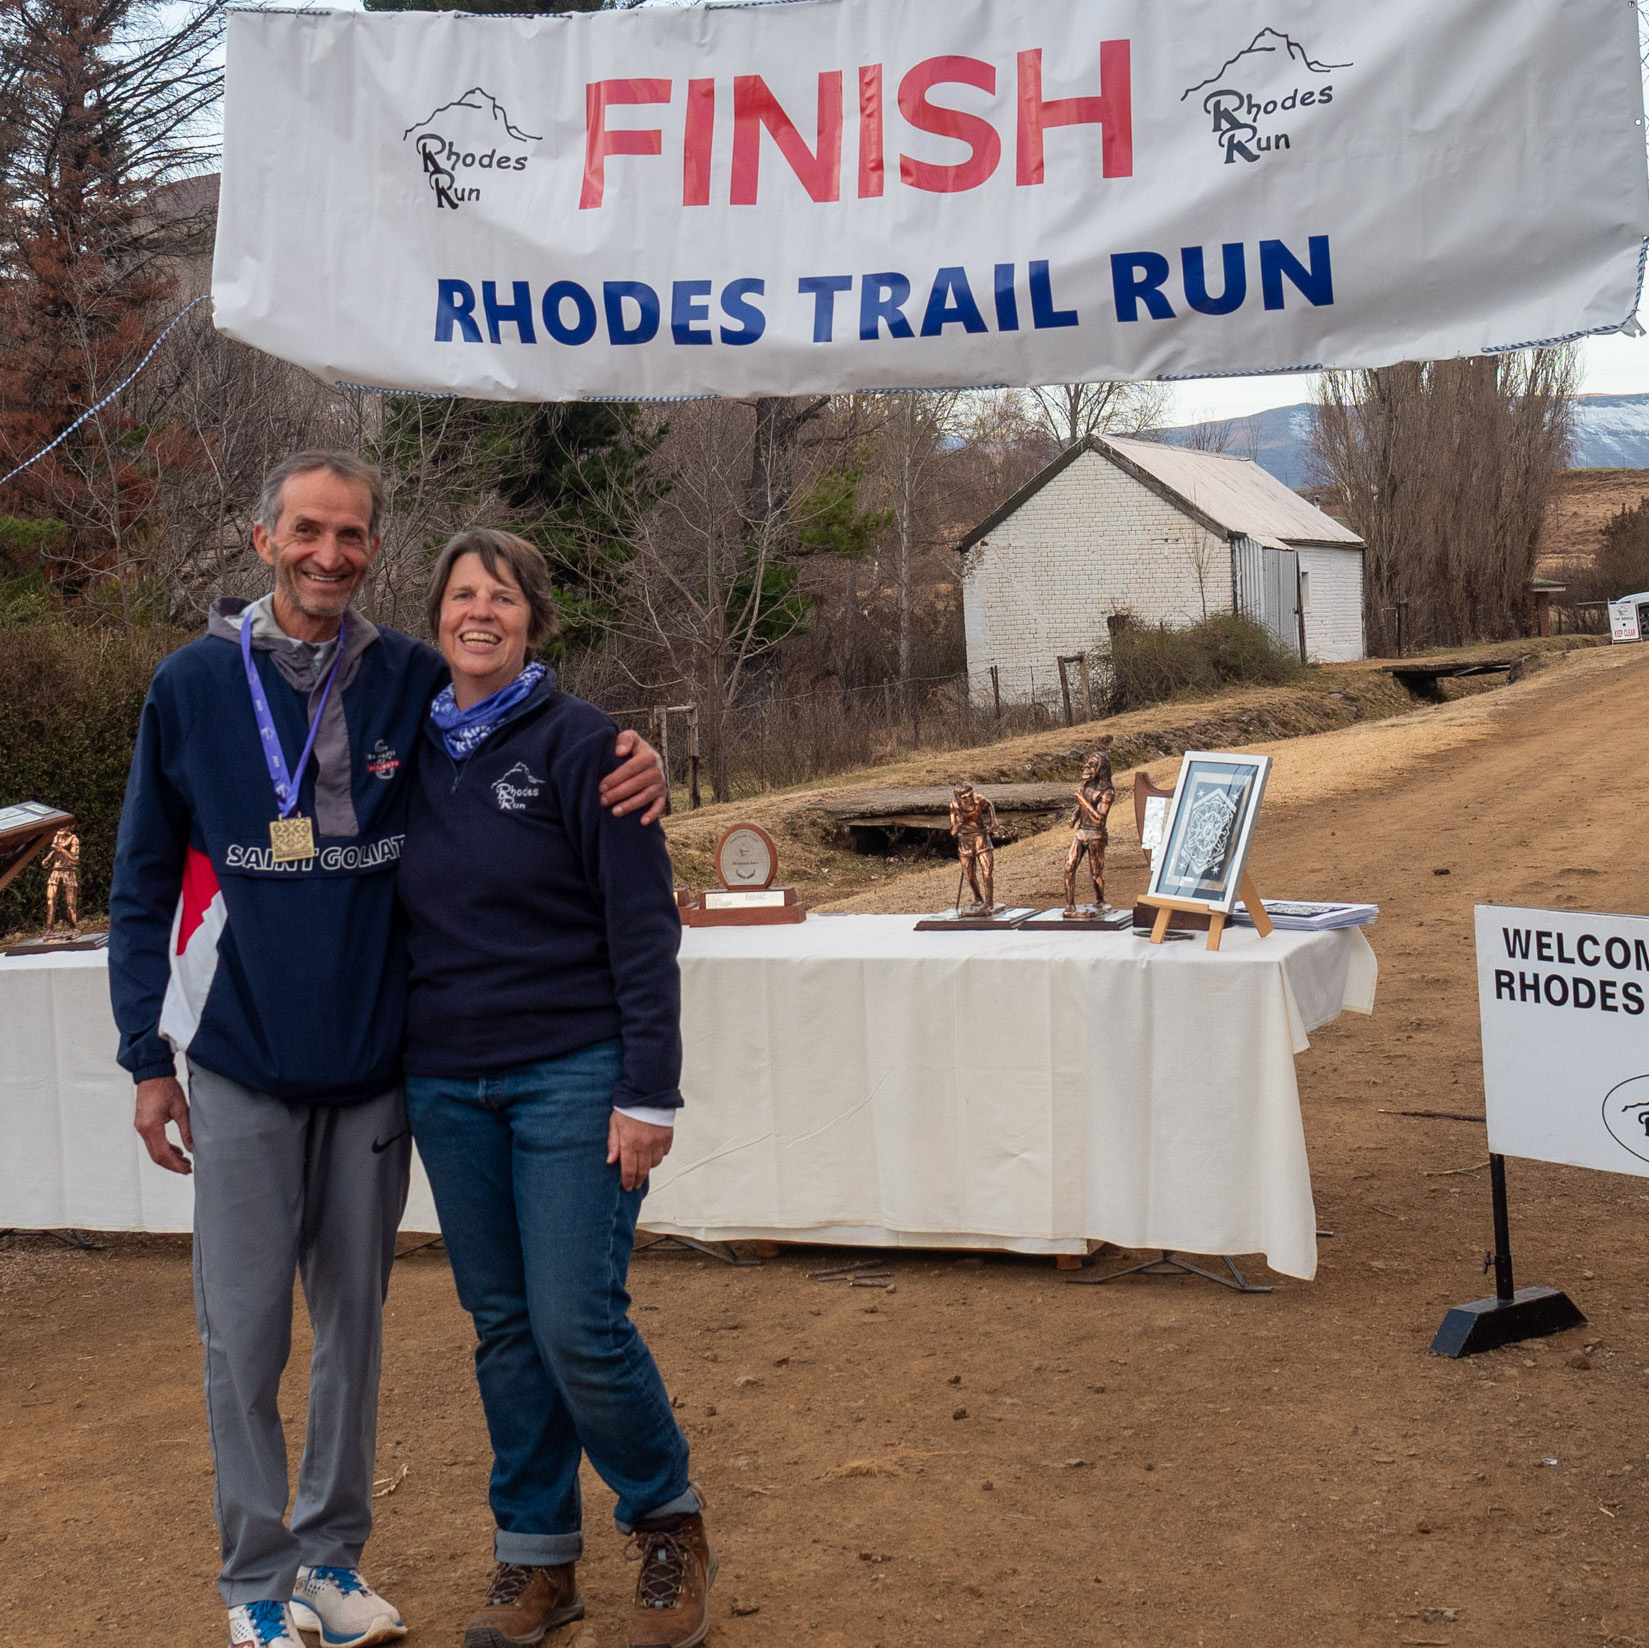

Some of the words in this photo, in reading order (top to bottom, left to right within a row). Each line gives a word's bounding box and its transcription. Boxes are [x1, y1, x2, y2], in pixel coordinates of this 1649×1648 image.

[580, 40, 1132, 209] FINISH
[1203, 84, 1334, 132] Rhodes
[416, 133, 529, 173] Rhodes
[1218, 123, 1291, 164] Run
[428, 168, 481, 209] Run
[434, 277, 766, 346] RHODES
[799, 260, 1079, 343] TRAIL
[1110, 235, 1334, 323] RUN
[496, 782, 540, 800] Rhodes
[498, 795, 526, 810] Run
[1494, 968, 1645, 1016] RHODES
